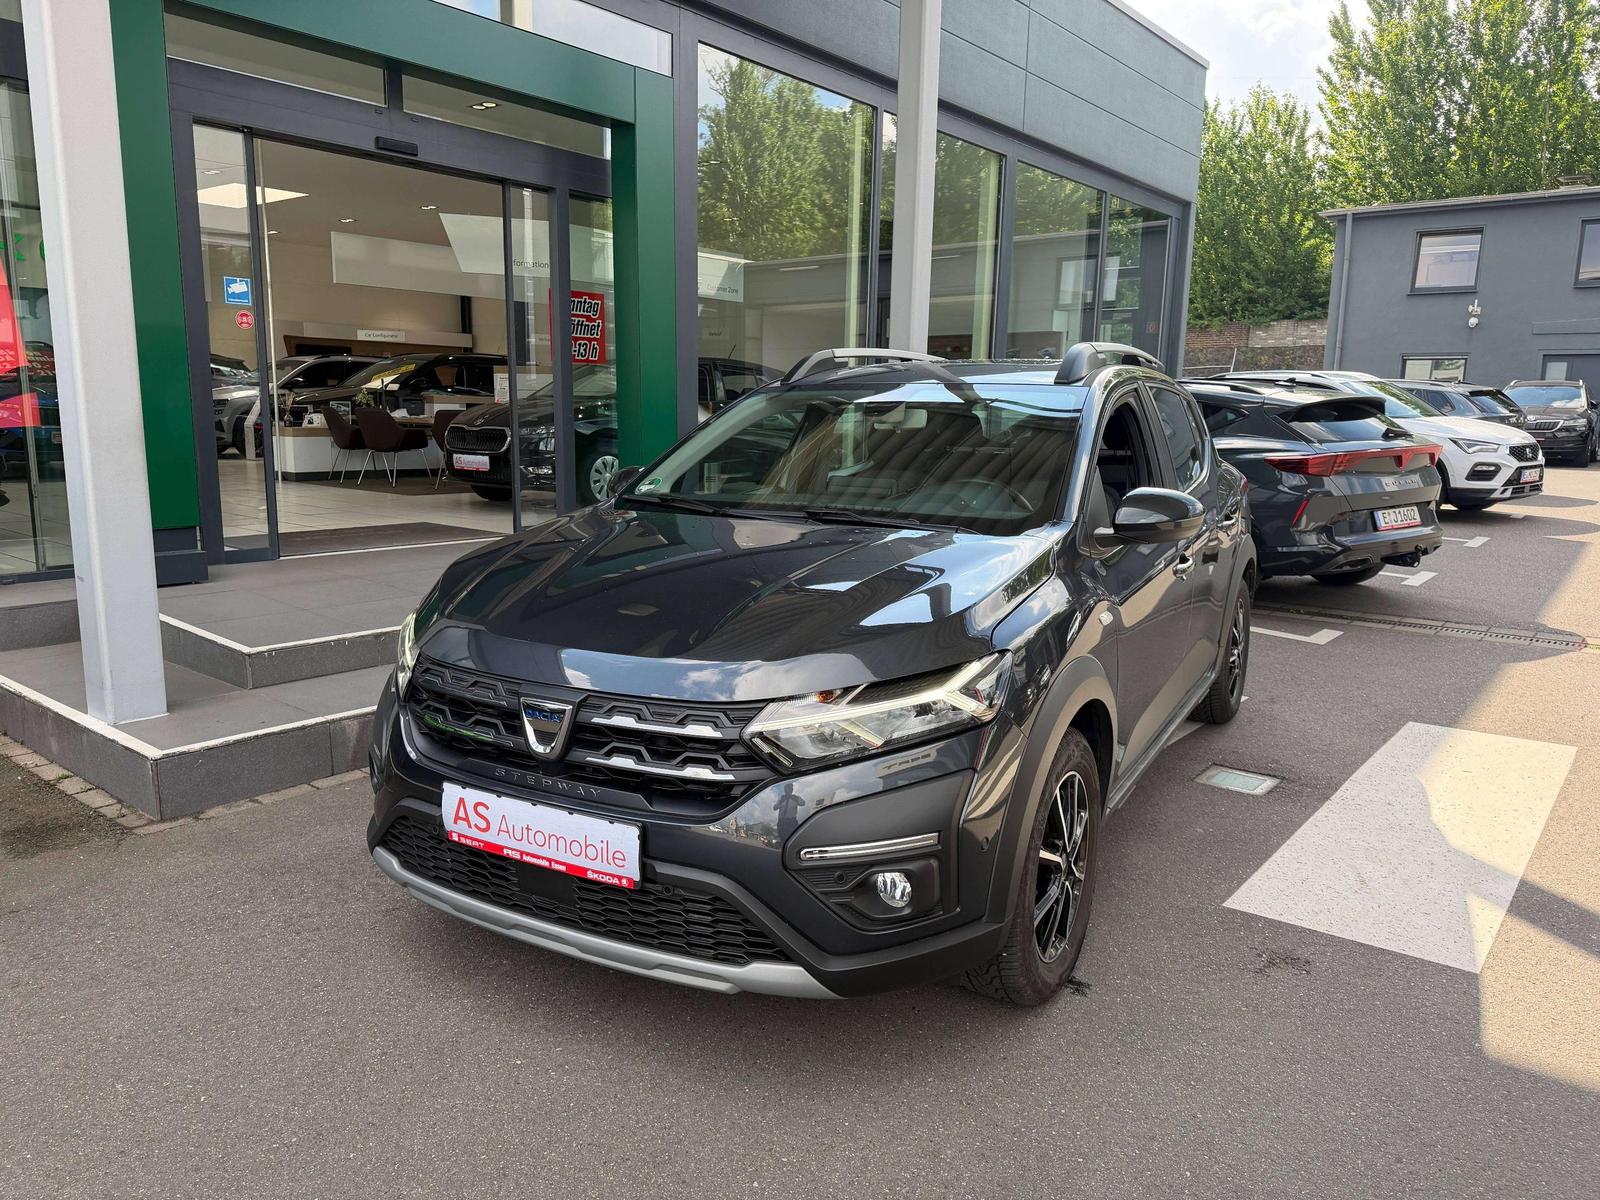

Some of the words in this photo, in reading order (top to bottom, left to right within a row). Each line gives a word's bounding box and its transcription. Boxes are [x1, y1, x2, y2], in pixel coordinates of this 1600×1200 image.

[590, 342, 599, 359] h
[1382, 511, 1390, 525] E
[494, 767, 601, 797] STEPWAY
[453, 796, 491, 833] AS
[496, 814, 626, 868] Automobile
[459, 836, 485, 849] SEAT
[587, 870, 620, 885] ŠKODA
